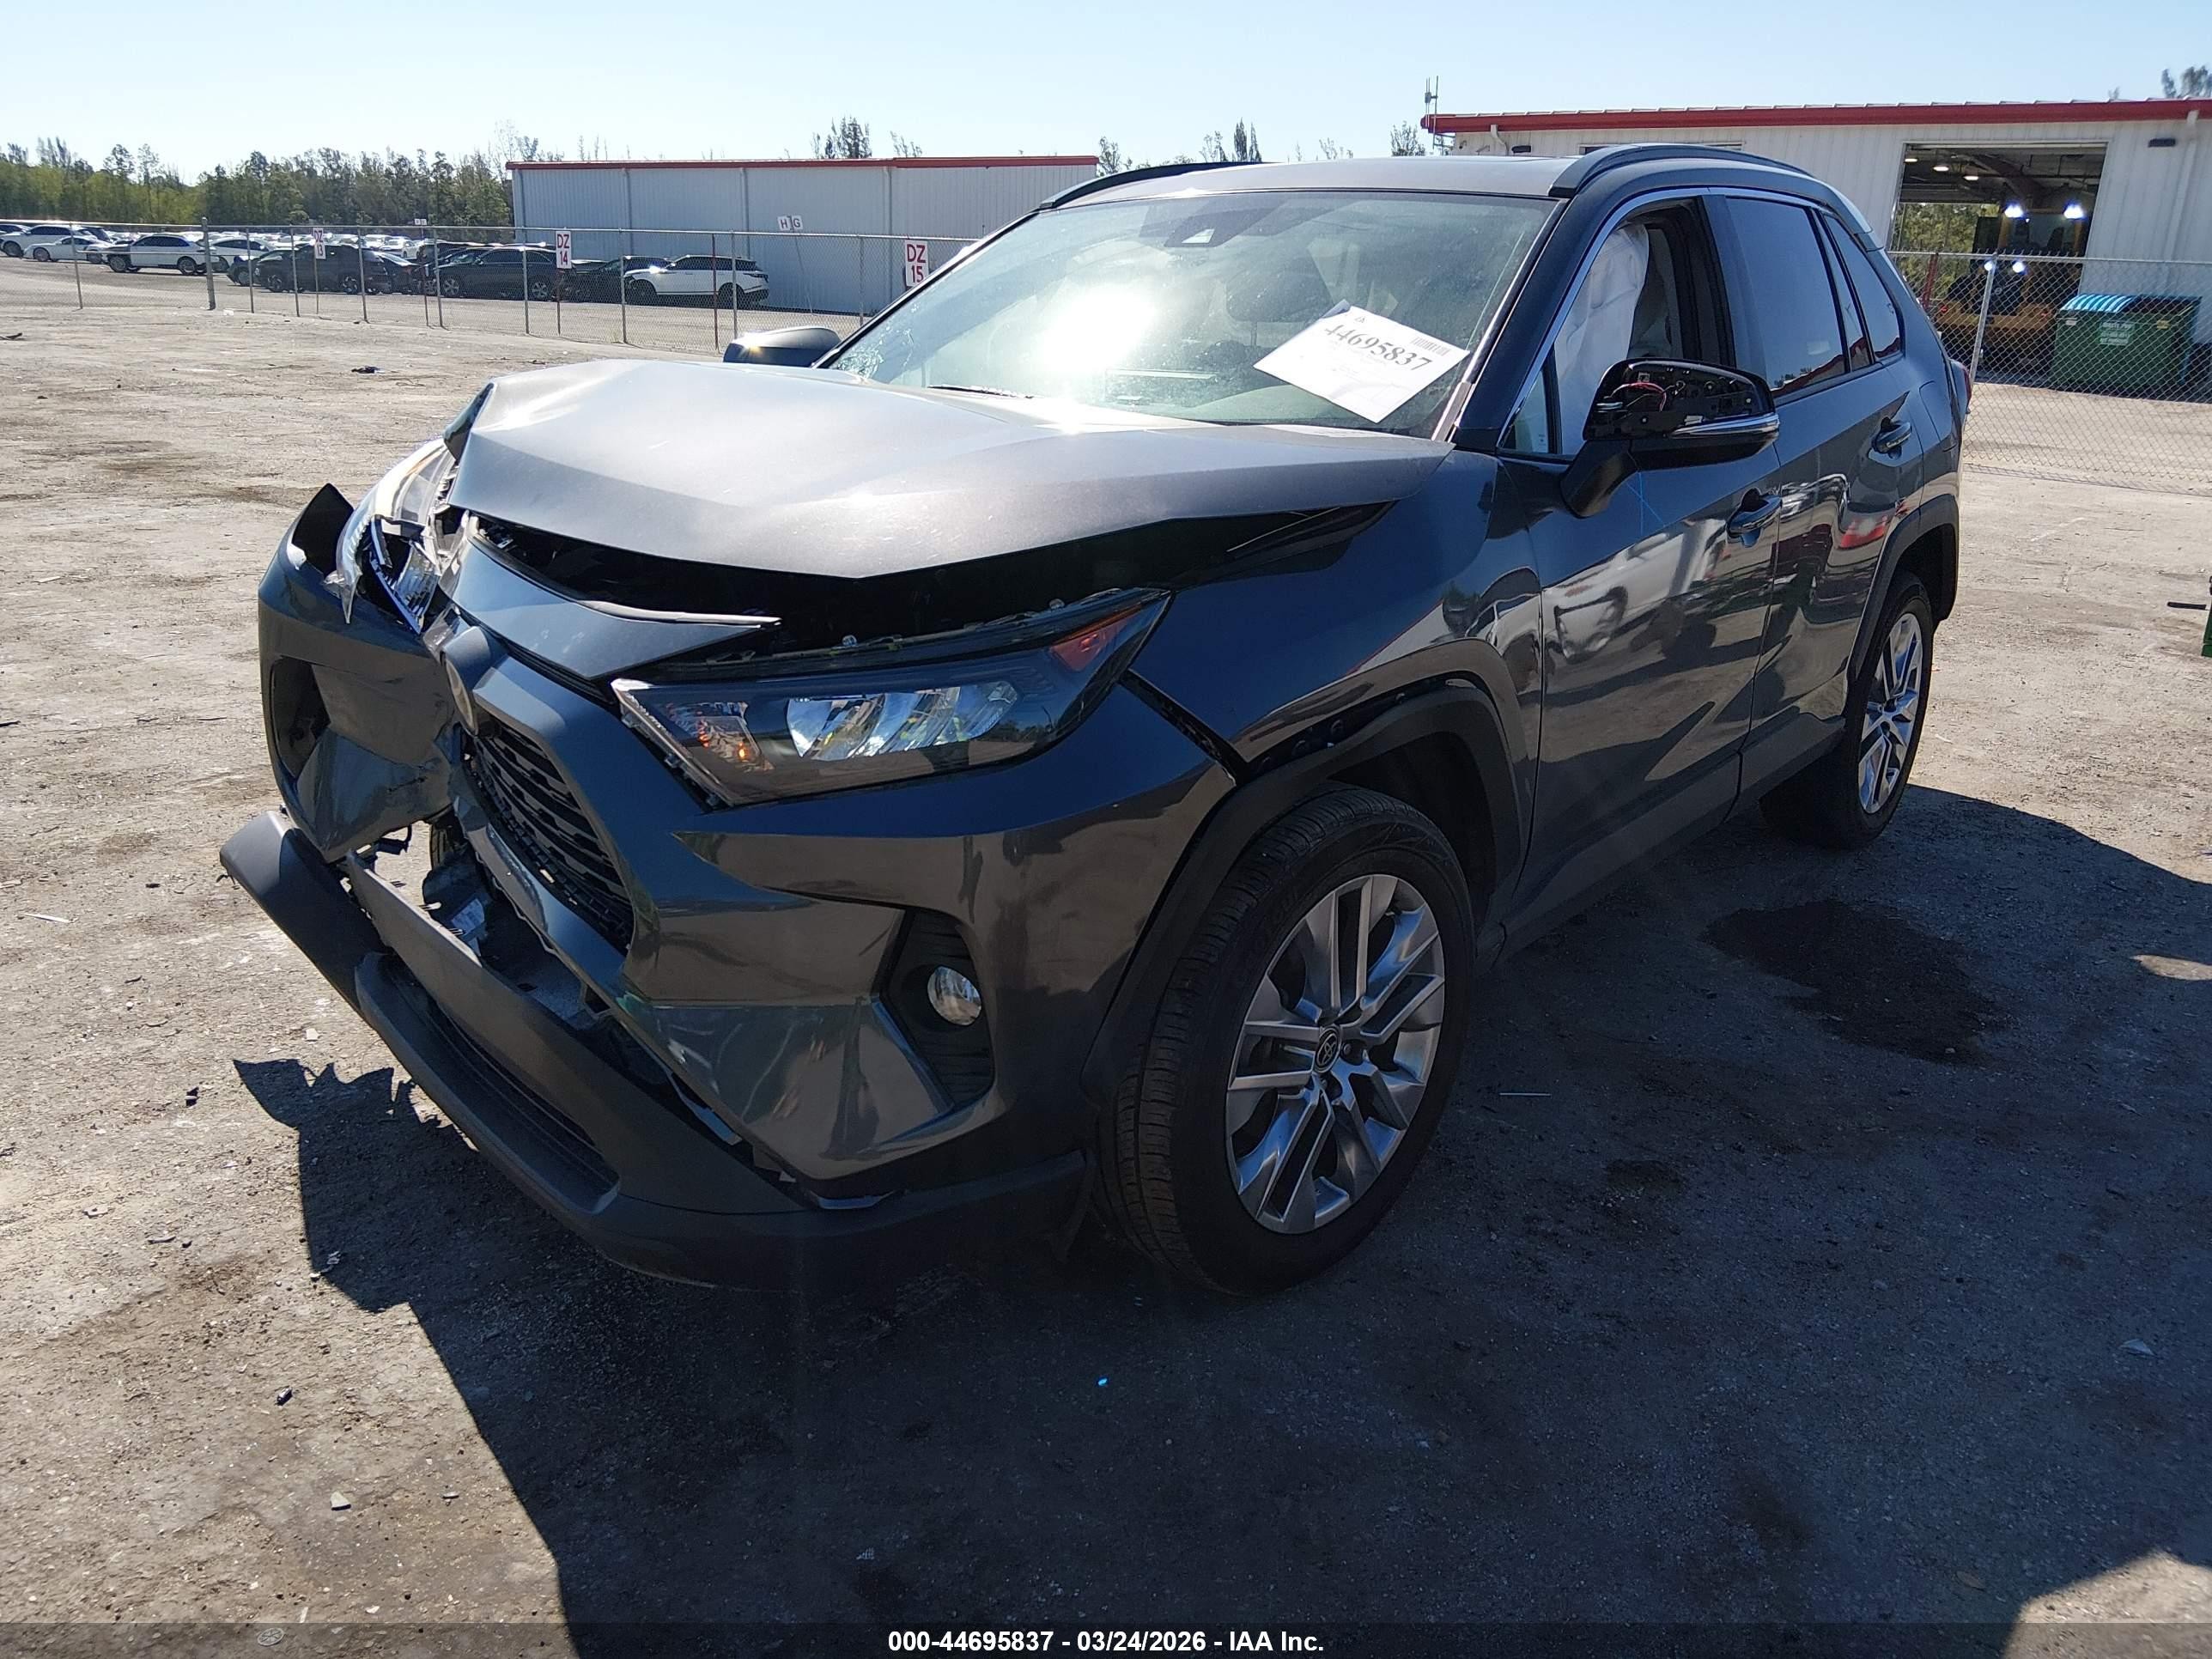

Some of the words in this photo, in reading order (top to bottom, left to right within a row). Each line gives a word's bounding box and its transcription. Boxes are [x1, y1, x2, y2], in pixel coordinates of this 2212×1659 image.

[780, 219, 788, 229] H
[793, 218, 801, 228] G
[556, 233, 570, 249] DZ
[559, 251, 568, 266] 14
[906, 243, 927, 264] DZ
[911, 264, 925, 283] 15
[1325, 324, 1433, 371] 44695837
